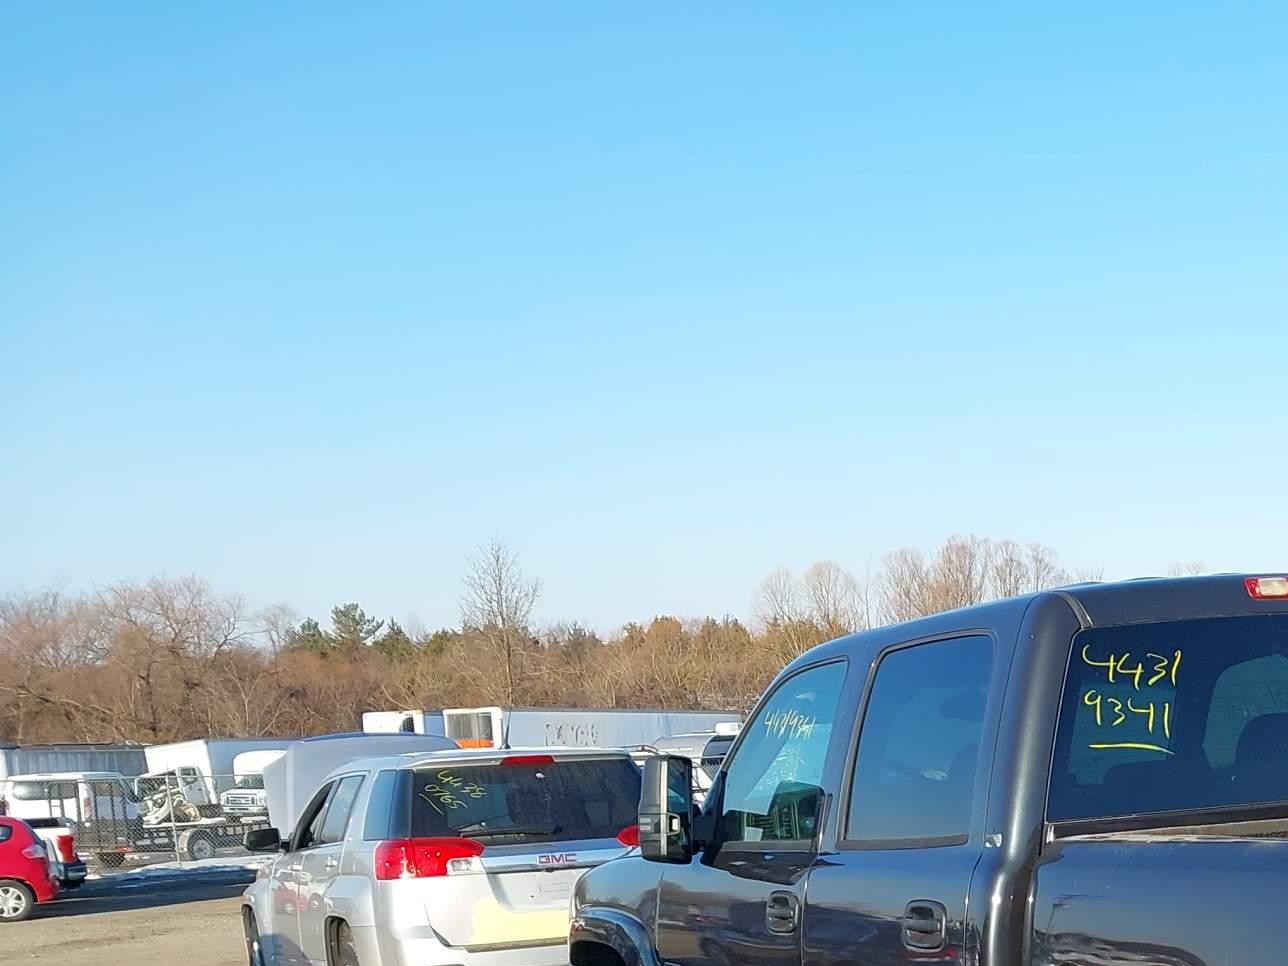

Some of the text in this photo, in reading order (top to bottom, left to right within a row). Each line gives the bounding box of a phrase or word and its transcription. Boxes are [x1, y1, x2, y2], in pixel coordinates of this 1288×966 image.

[1082, 644, 1182, 690] 4431
[1083, 690, 1170, 739] 9341
[537, 853, 577, 864] GMC
